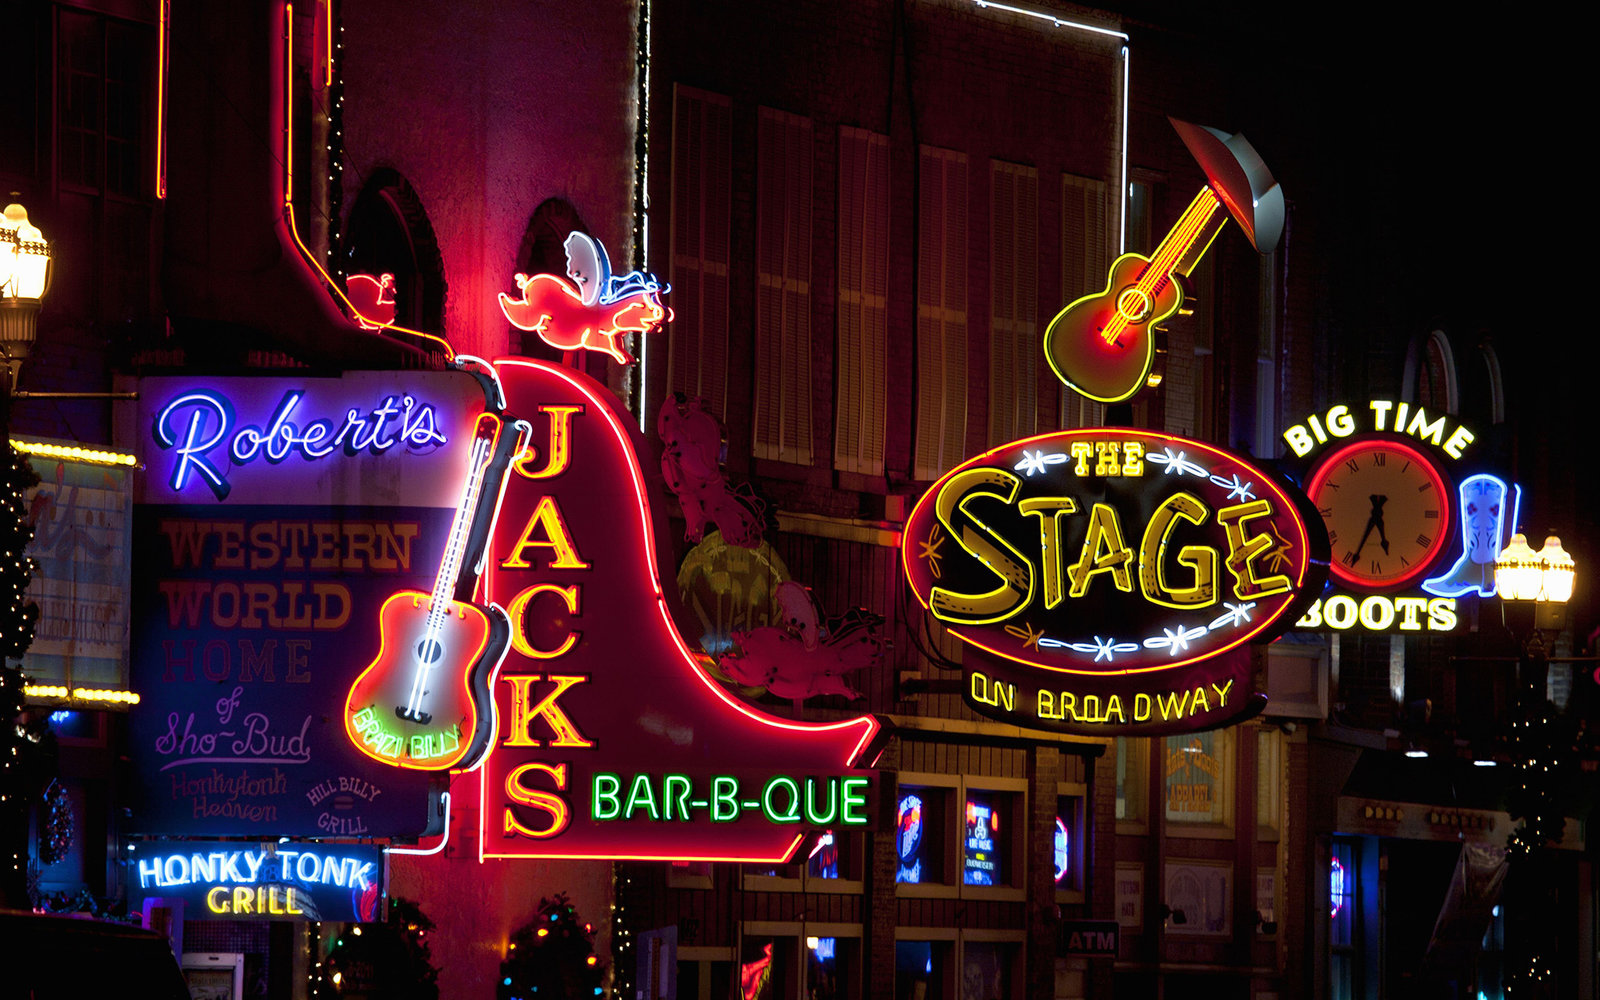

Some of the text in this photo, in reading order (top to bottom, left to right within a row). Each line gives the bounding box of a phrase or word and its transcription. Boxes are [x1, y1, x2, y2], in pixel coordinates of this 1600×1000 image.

[153, 388, 447, 500] Robert's
[1283, 400, 1475, 460] BIG TIME
[1070, 441, 1146, 477] THE
[159, 520, 419, 571] WESTERN
[928, 467, 1294, 626] STAGE
[159, 580, 352, 631] WORLD
[499, 403, 597, 839] JACKS
[162, 639, 313, 683] HOME
[215, 686, 244, 724] of
[970, 672, 1235, 724] ON BROADWAY
[169, 767, 288, 801] Honkytonk
[306, 776, 382, 807] HILL BILLY
[591, 771, 869, 826] BAR-B-QUE
[193, 797, 278, 823] Heaven
[316, 811, 369, 835] GRILL
[138, 850, 378, 892] HONKY TONK
[206, 885, 304, 916] GRILL
[1068, 931, 1116, 951] ATM
